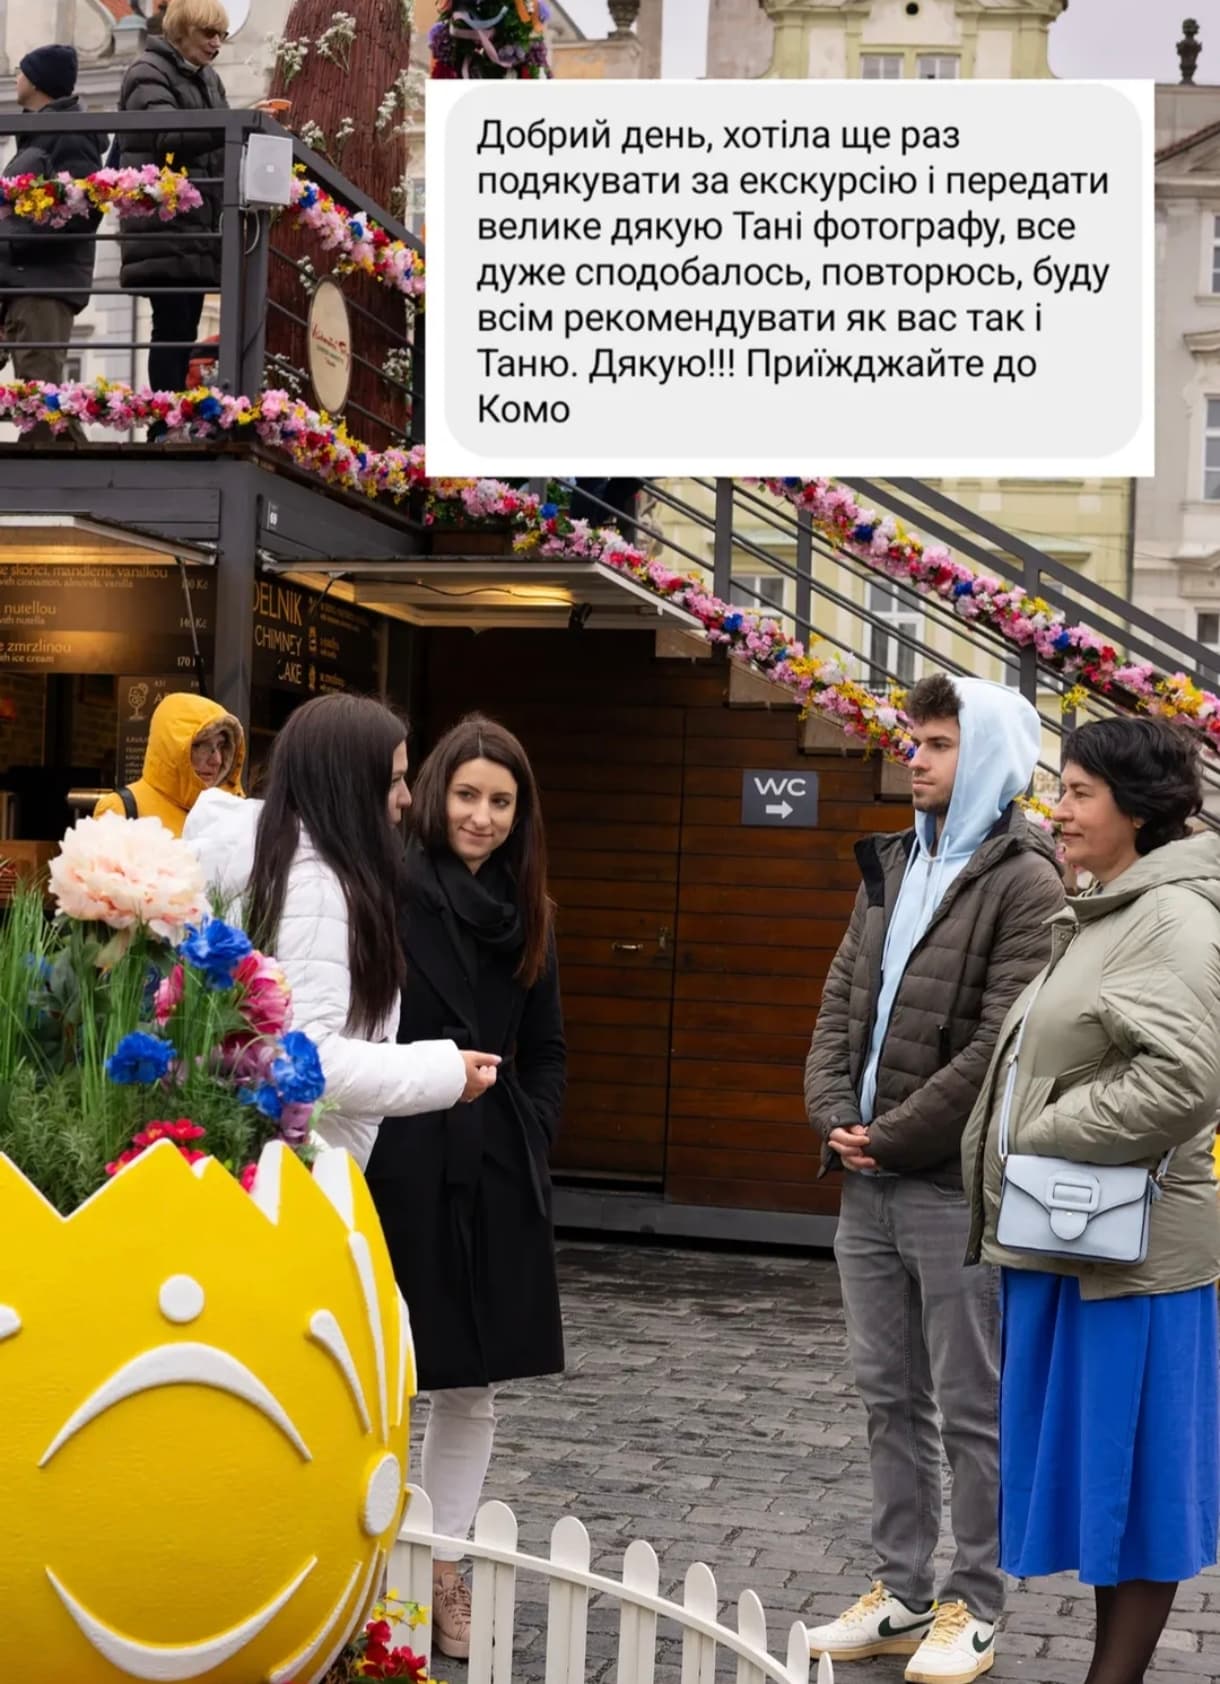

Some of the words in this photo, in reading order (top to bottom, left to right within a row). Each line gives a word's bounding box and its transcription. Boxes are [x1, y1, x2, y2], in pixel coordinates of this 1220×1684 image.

[4, 600, 57, 615] nutellou
[7, 638, 72, 653] zmrzlinou
[12, 654, 25, 663] ice
[26, 655, 55, 664] cream
[753, 776, 806, 797] WC
